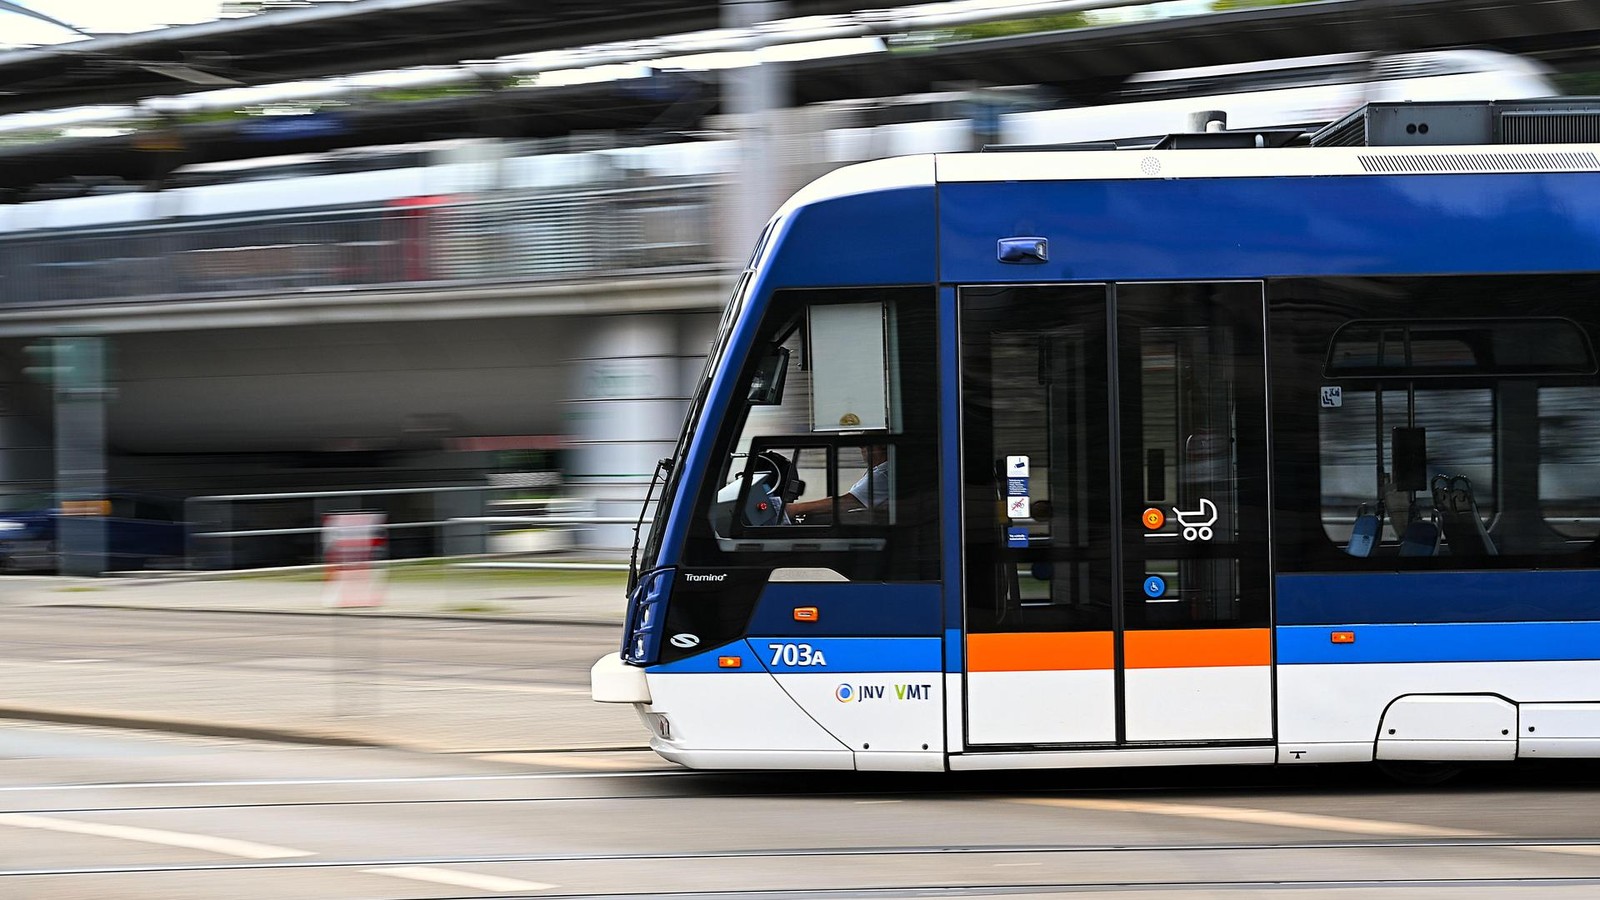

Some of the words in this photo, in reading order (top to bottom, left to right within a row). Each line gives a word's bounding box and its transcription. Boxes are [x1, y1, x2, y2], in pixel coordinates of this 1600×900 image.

[768, 643, 827, 666] 703A
[858, 686, 885, 702] JNV
[894, 684, 931, 700] VMT
